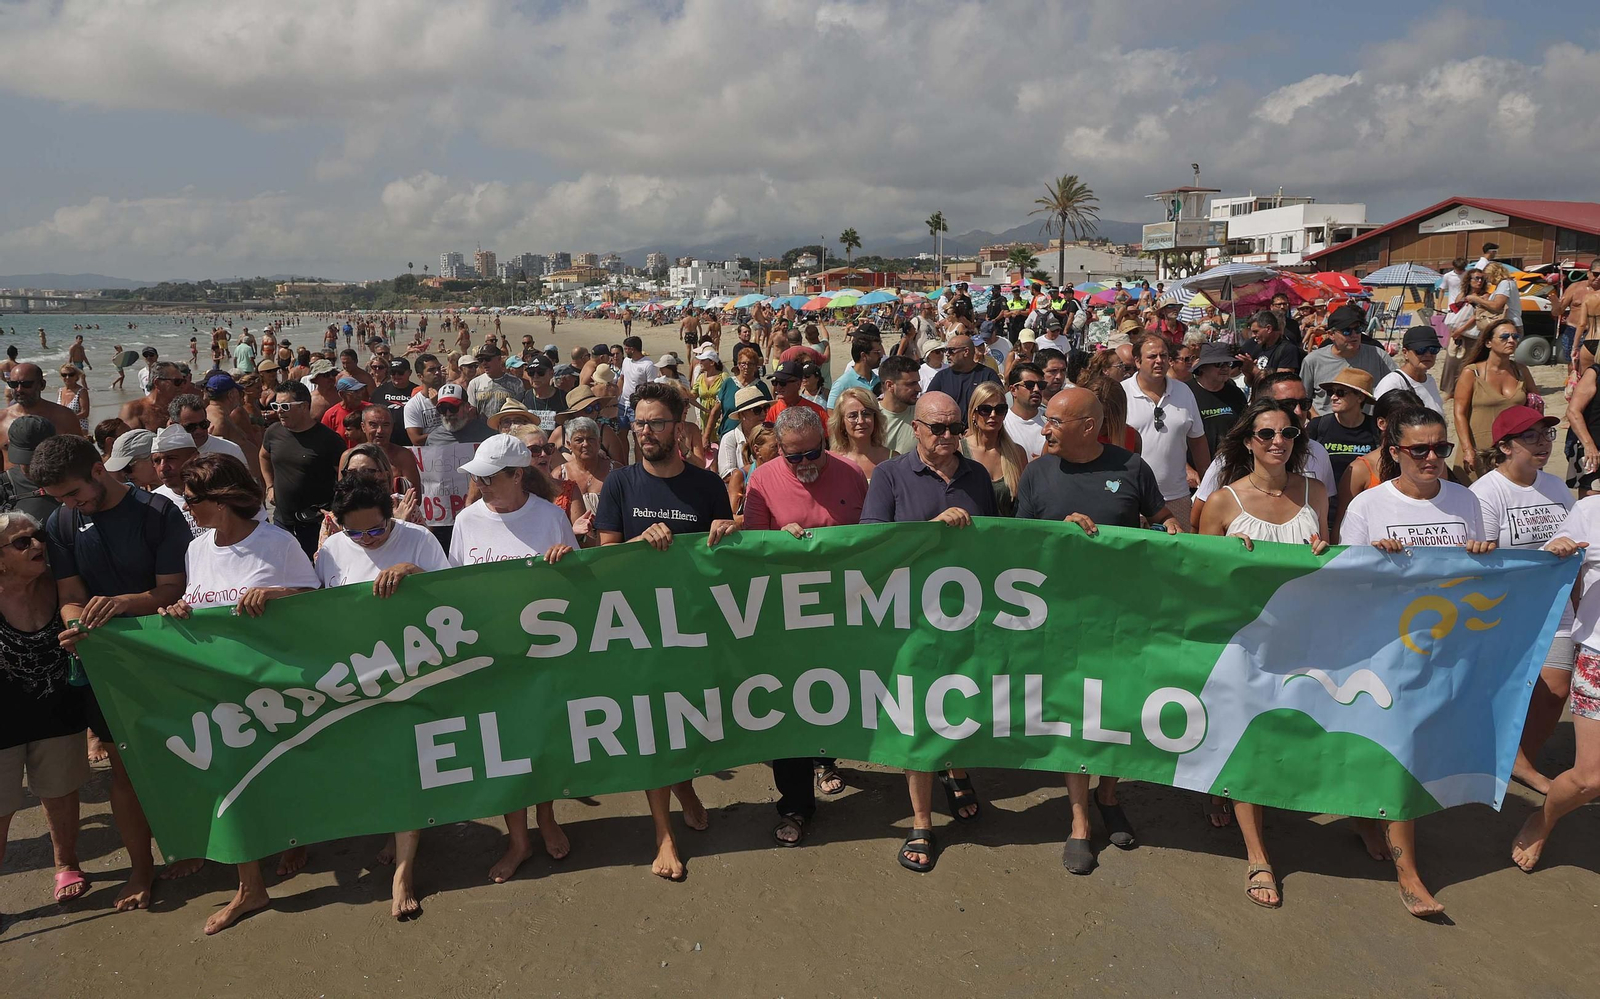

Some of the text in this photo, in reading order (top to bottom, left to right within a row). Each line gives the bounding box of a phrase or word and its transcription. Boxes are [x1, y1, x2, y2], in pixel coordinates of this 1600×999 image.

[1201, 406, 1233, 416] VERDEMAR
[1324, 442, 1372, 453] VERDEMAR
[423, 496, 447, 522] OS
[632, 507, 698, 522] Pedro del Hierro
[1522, 507, 1551, 516] PLAYA
[1516, 513, 1567, 527] EL RINCONCILLO
[1408, 526, 1449, 536] PLAYA
[1532, 525, 1553, 533] MEJOR
[1398, 534, 1467, 546] EL RINCONCILLO
[1532, 531, 1556, 541] MUND
[519, 566, 1048, 658] SALVEMOS
[165, 605, 479, 771] VERDEMAR
[414, 667, 1207, 790] EL RINCONCILLO
